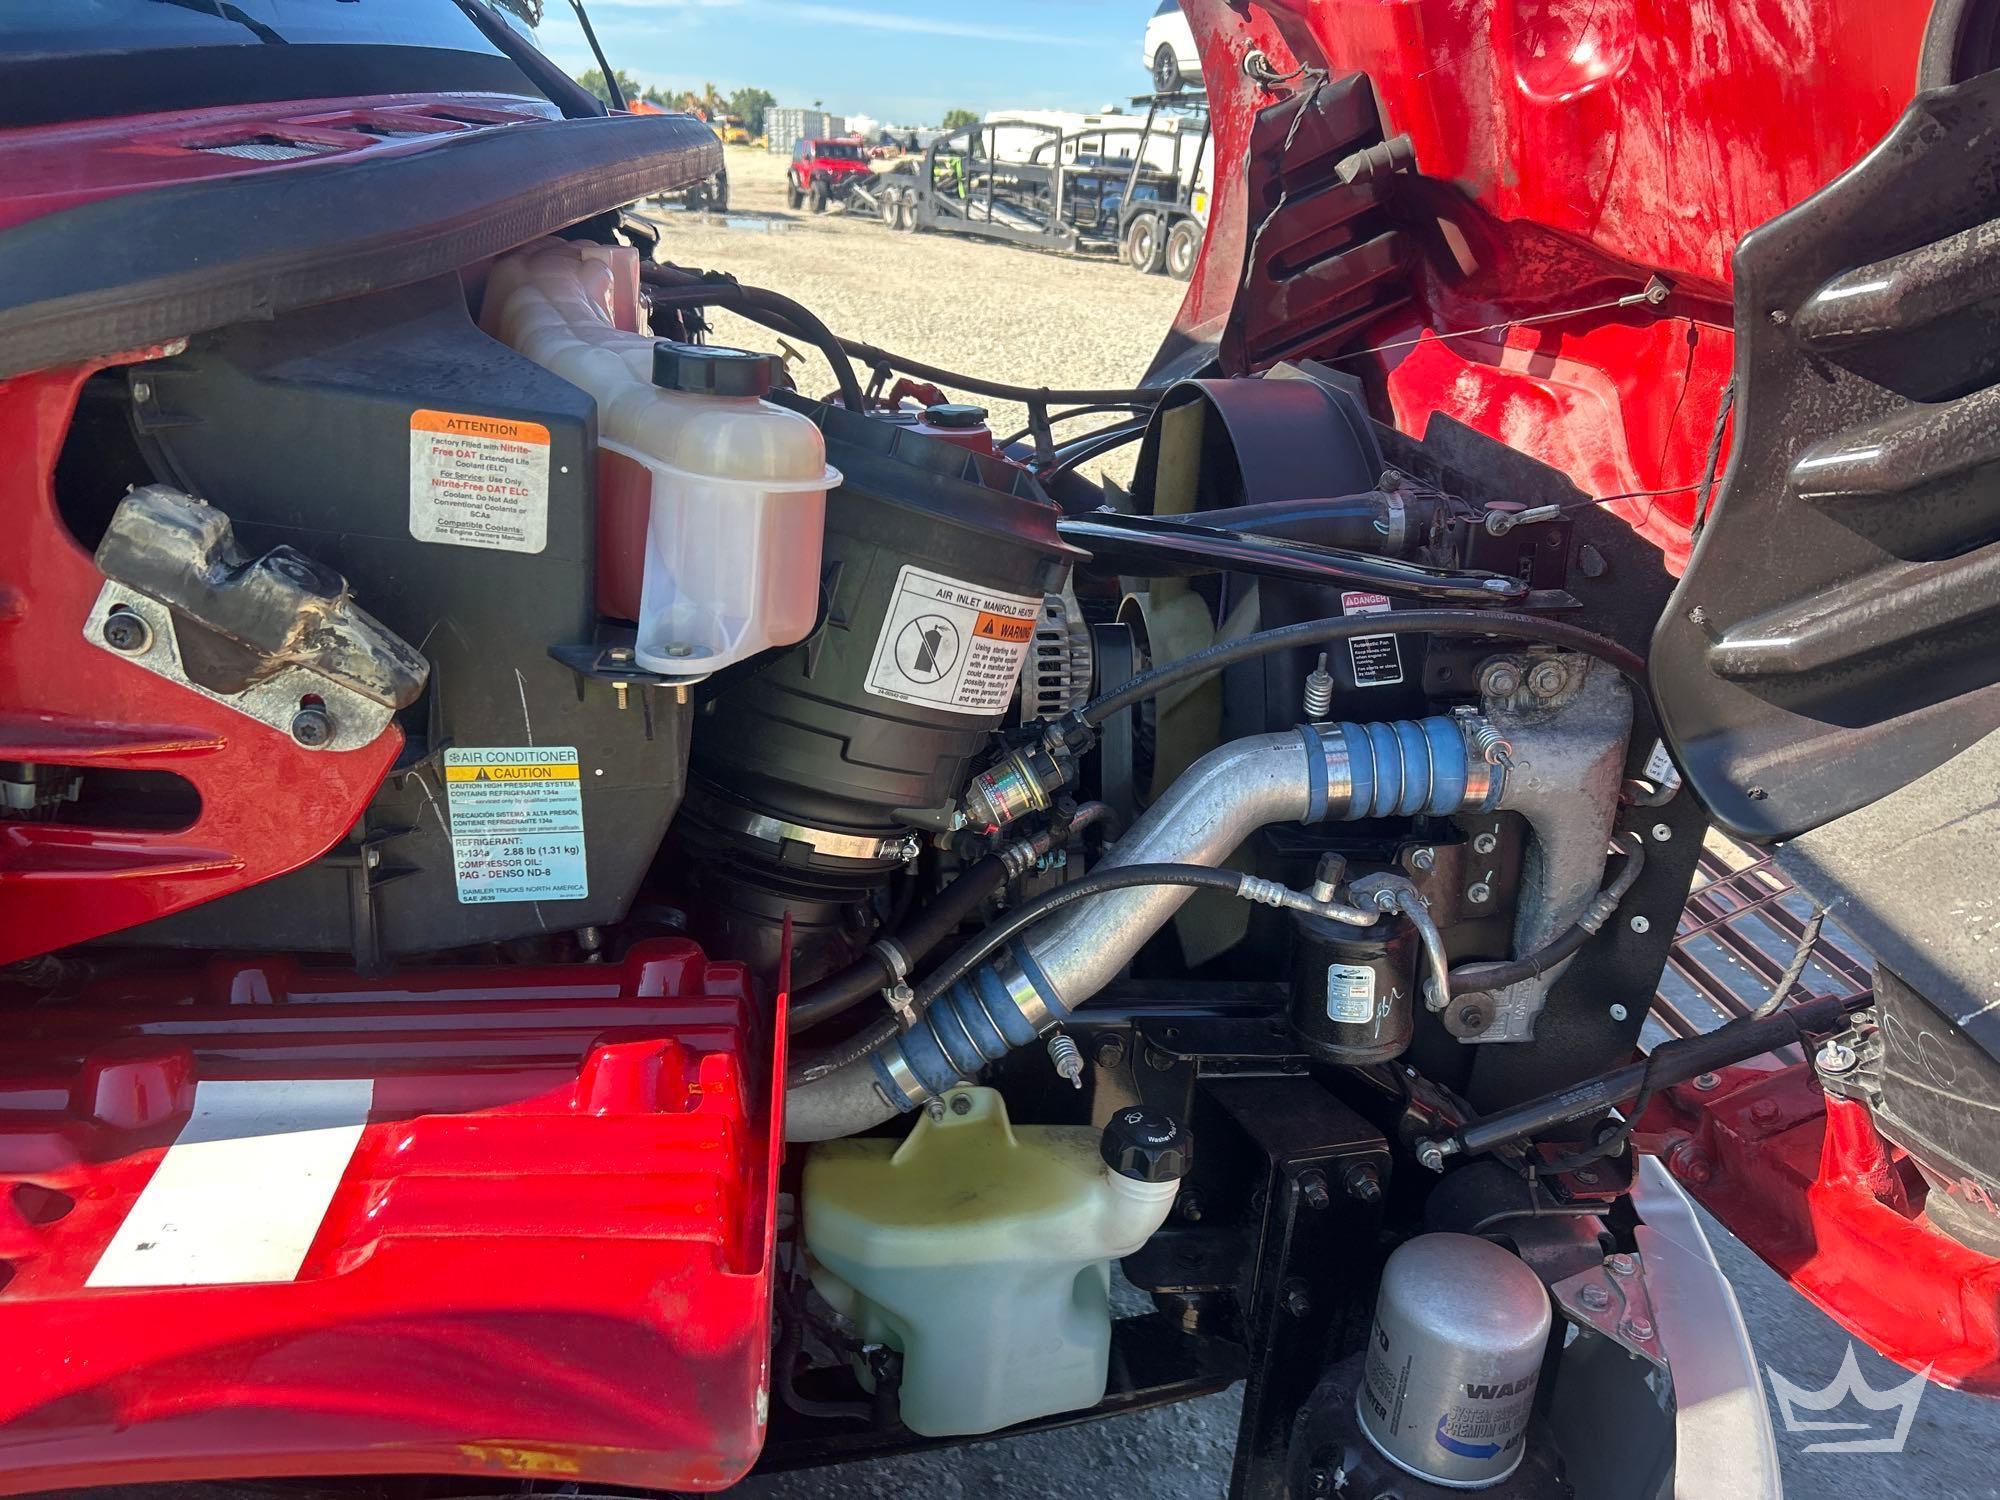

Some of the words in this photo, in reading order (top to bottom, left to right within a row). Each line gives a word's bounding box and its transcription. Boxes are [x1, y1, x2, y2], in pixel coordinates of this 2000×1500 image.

[448, 419, 518, 435] ATTENTION
[432, 437, 459, 446] Factory
[500, 444, 531, 454] Nitrite-
[432, 447, 454, 456] Free
[456, 450, 476, 458] OAT
[480, 454, 514, 464] Extended
[456, 461, 484, 470] Coolant
[486, 464, 507, 473] (ELC)
[455, 472, 485, 482] Service:
[505, 478, 522, 486] Only
[432, 479, 483, 492] Nitrite-Free
[486, 484, 506, 494] OAT
[510, 486, 528, 496] ELC
[434, 499, 482, 509] Conventional
[485, 504, 517, 513] Coolants
[438, 518, 482, 530] Compatible
[450, 528, 472, 536] Engine
[936, 589, 953, 600] AIR
[957, 593, 981, 608] INLET
[983, 600, 1016, 616] MANIFOLD
[1354, 595, 1387, 605] DANGER
[1000, 624, 1032, 638] WARNING
[976, 643, 991, 654] Using
[964, 679, 986, 688] possibly
[461, 753, 483, 763] AIR
[486, 751, 576, 762] CONDITIONER
[494, 768, 551, 779] CAUTION
[456, 838, 523, 846] REFRIGERANT:
[539, 847, 561, 856] (1.31
[565, 846, 579, 855] kg)
[458, 860, 521, 868] COMPRESSOR
[460, 871, 479, 879] PAG
[489, 870, 524, 878] DENSO
[1046, 885, 1099, 909] BURGAFLEX
[1450, 1406, 1493, 1423] SYSTEM
[1446, 1421, 1497, 1438] PREMIUM
